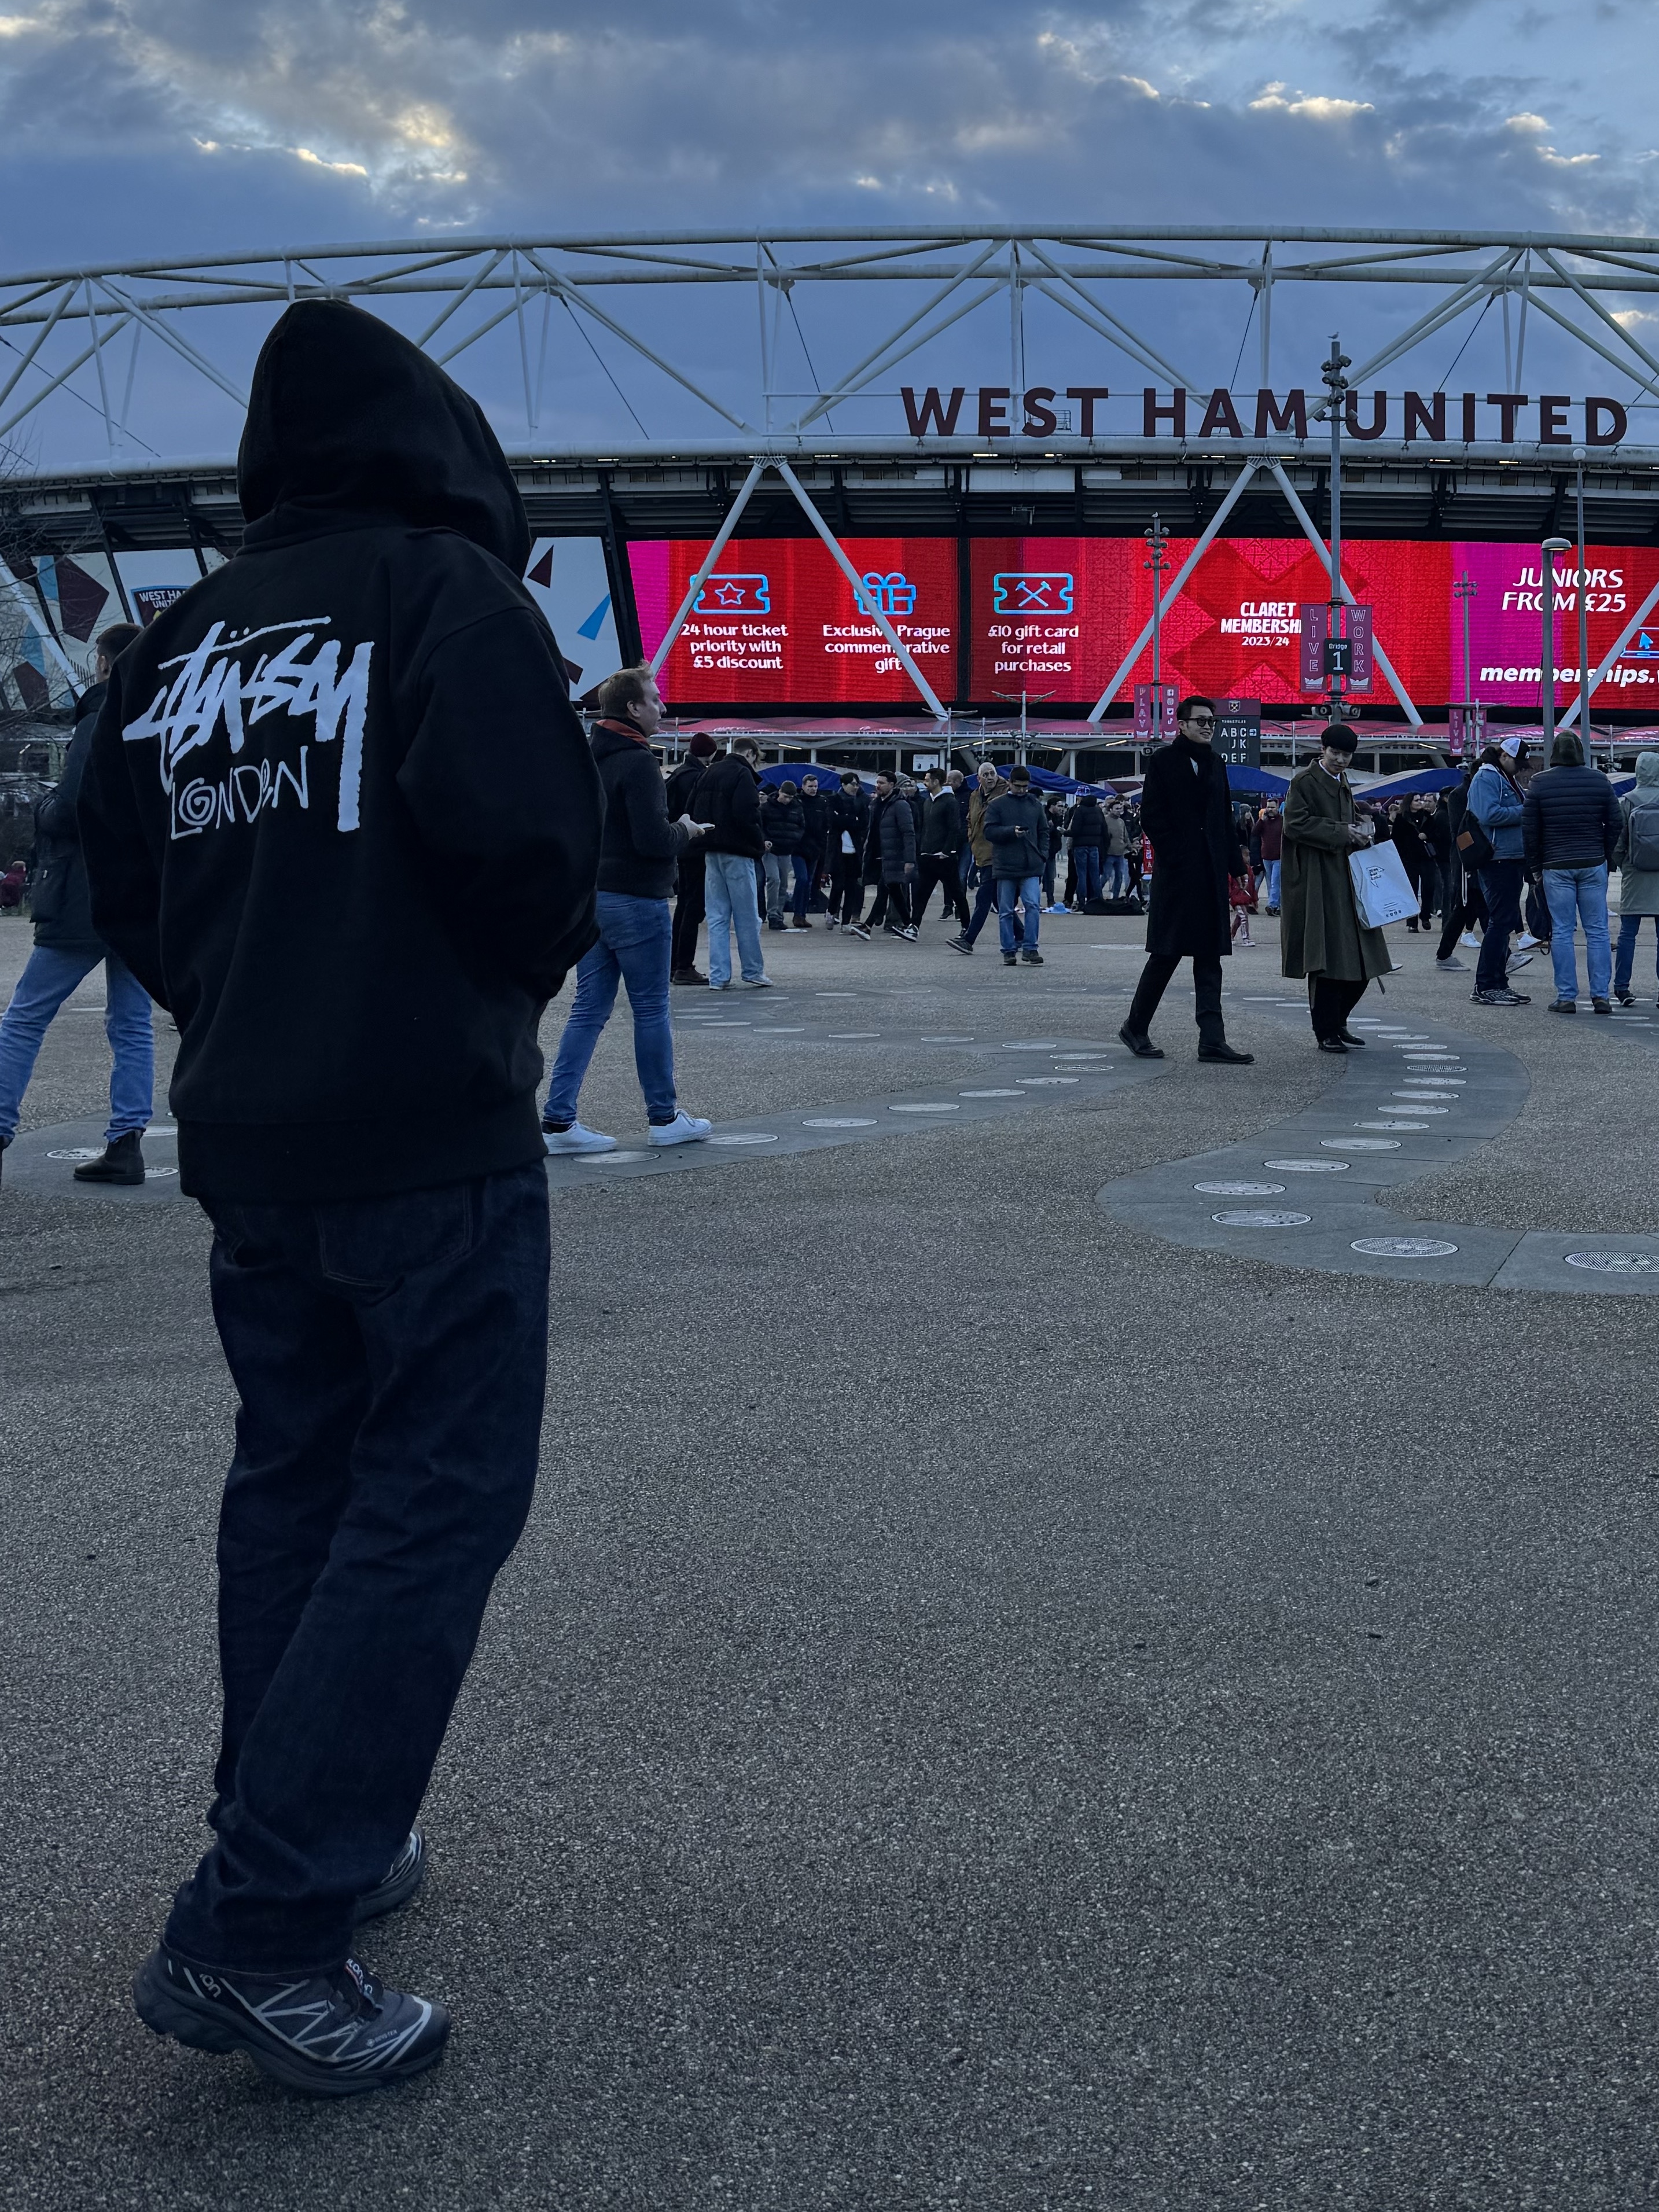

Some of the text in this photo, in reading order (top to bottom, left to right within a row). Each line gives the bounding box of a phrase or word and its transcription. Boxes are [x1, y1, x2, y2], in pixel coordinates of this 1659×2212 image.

[900, 387, 1627, 446] WEST HAM UNITED
[1513, 568, 1623, 588] JUNIORS
[139, 590, 186, 602] WEST HA
[152, 599, 176, 608] UNIT
[1585, 593, 1626, 612] £25
[1240, 602, 1296, 617] CLARET
[681, 624, 789, 636] 24 hour ticket
[823, 624, 950, 640] Exclusiv Prague
[988, 624, 1079, 641] £10 gift card
[1220, 618, 1302, 634] MEMBERSHI
[690, 639, 782, 655] priority with
[825, 641, 951, 654] commemrative
[1001, 642, 1066, 654] for retail
[1241, 636, 1290, 646] 2023/24
[1308, 609, 1319, 672] LIVE
[1351, 609, 1366, 672] WORK
[693, 655, 784, 669] £5 discount
[874, 657, 903, 673] gift
[995, 659, 1072, 674] purchases
[1333, 651, 1344, 671] 1
[1220, 727, 1247, 737] A B C
[1231, 739, 1246, 749] J K
[1231, 753, 1237, 763] E
[1240, 753, 1246, 763] F
